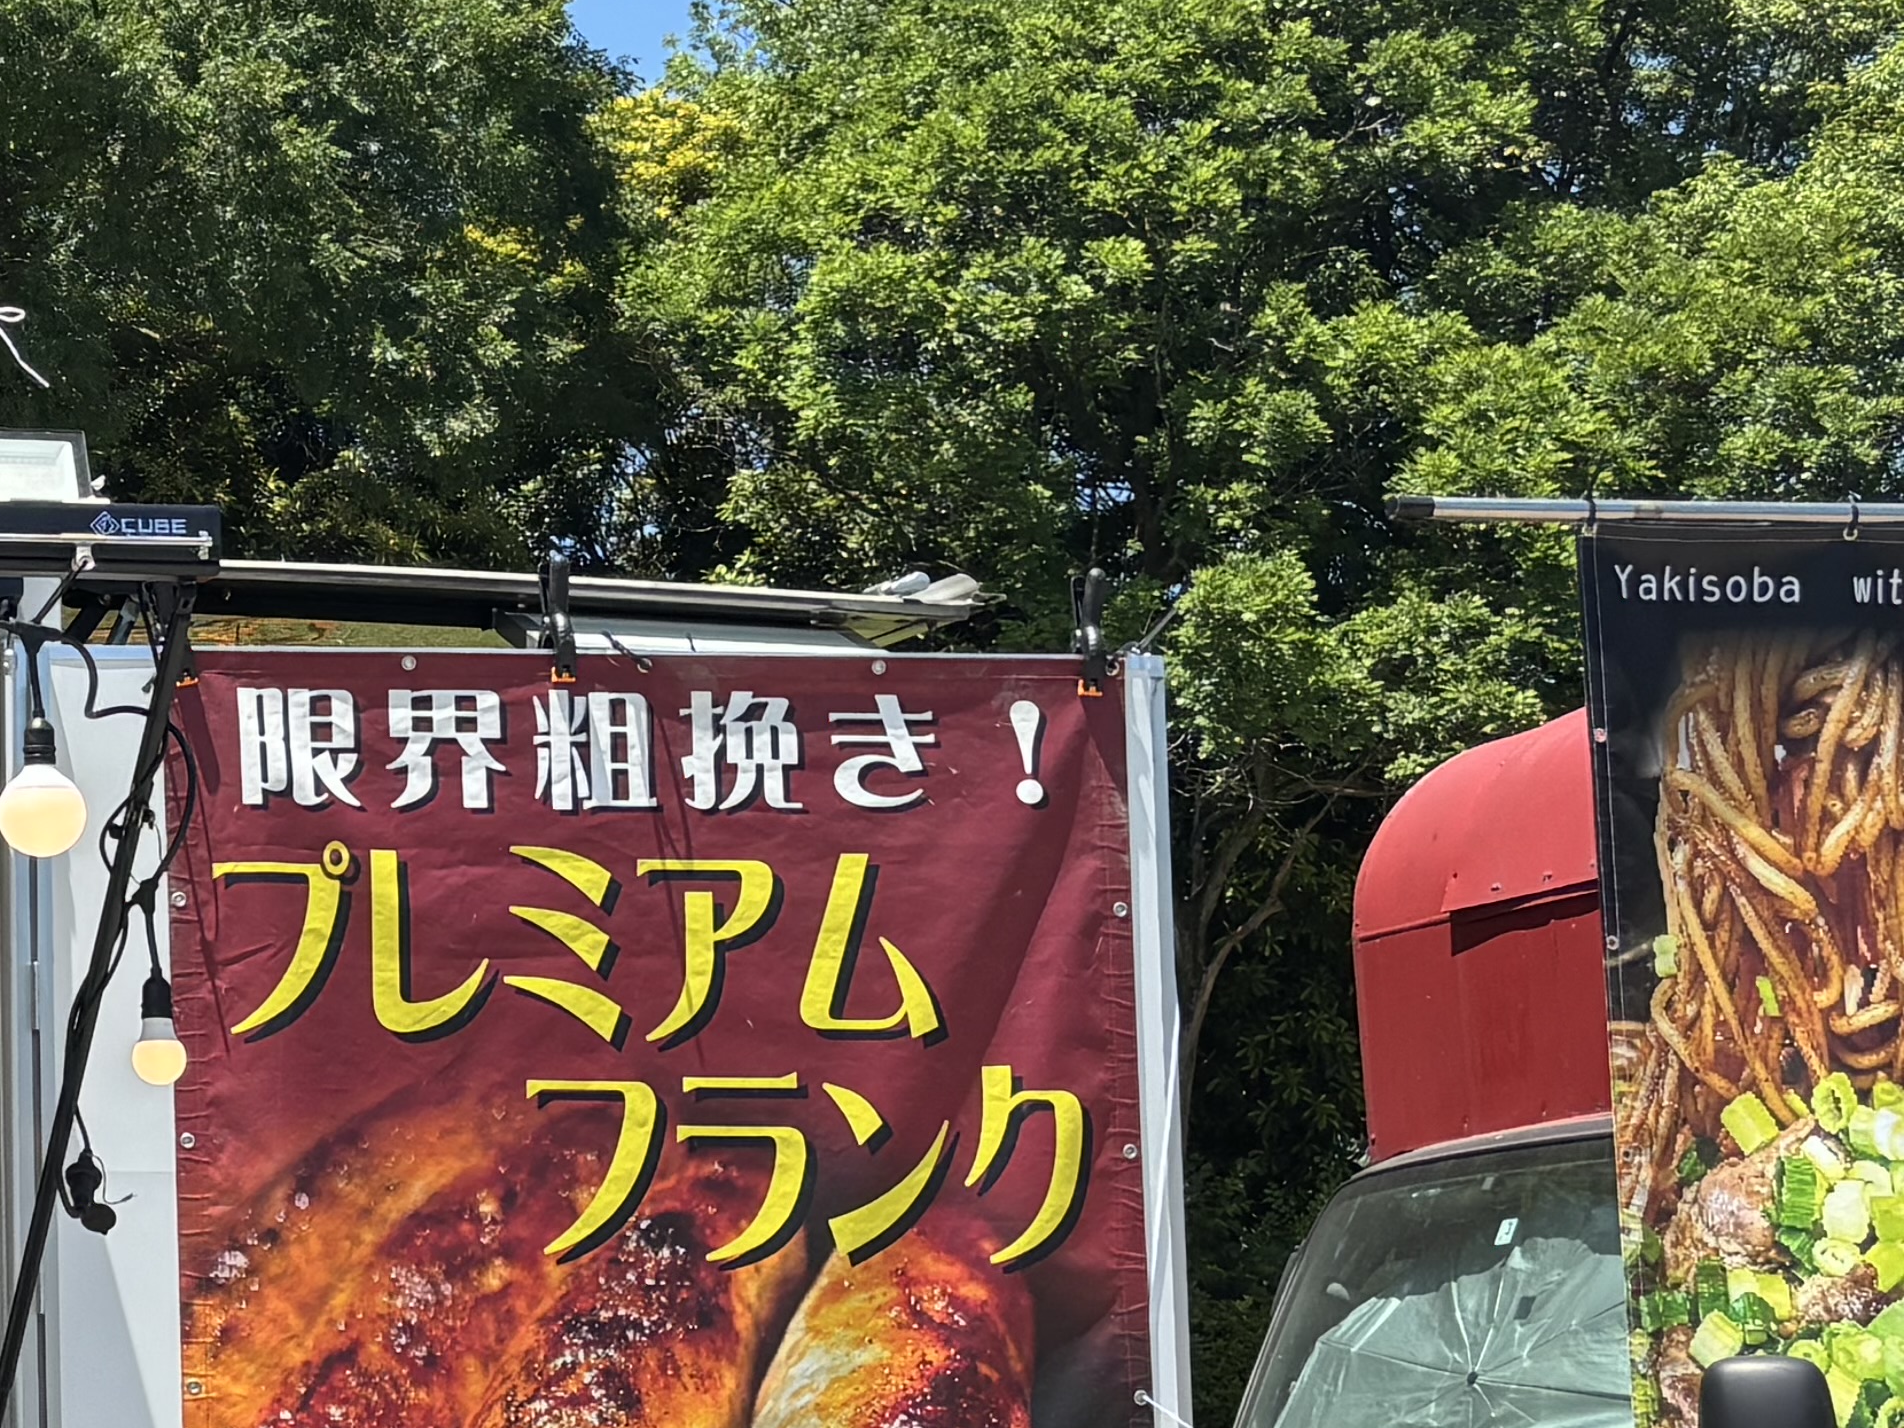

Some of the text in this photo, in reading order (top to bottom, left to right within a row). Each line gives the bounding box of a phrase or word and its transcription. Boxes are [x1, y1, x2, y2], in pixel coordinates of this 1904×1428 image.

[121, 518, 188, 534] CUBE
[1614, 564, 1801, 605] Yakisoba
[236, 685, 1049, 814] 限界粗挽き！
[211, 838, 950, 1049] プレミアム
[524, 1063, 1092, 1271] フランク
